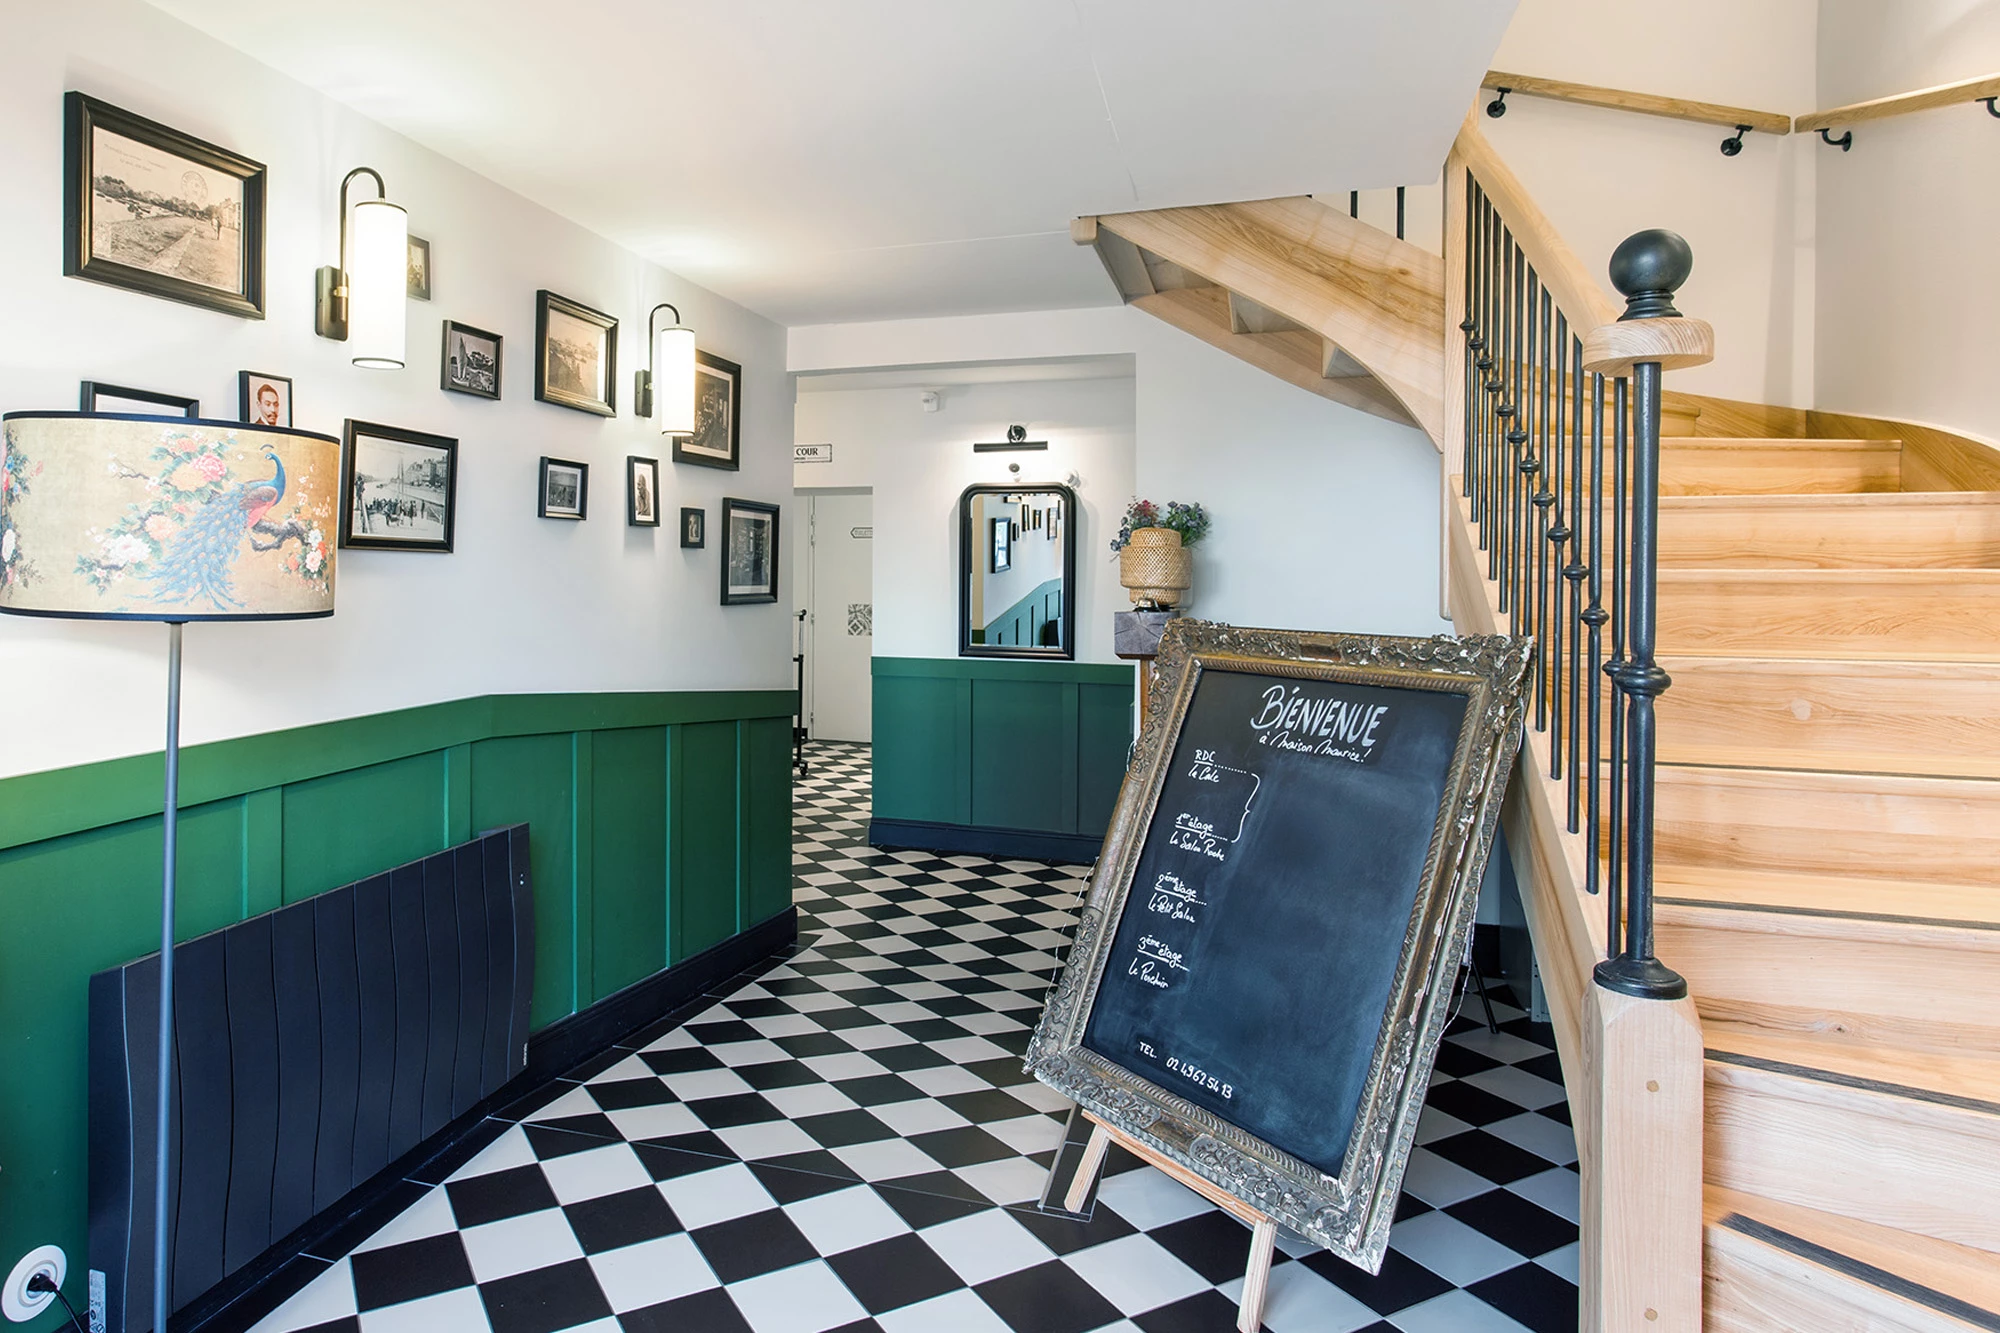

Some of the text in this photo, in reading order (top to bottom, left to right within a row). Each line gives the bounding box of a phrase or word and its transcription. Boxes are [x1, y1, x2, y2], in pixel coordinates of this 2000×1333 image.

[796, 447, 818, 456] COUR
[1259, 731, 1270, 744] à
[1195, 749, 1216, 763] RDC
[1188, 817, 1214, 839] étage
[1180, 833, 1201, 852] Salon
[1171, 902, 1195, 923] Salon
[1158, 944, 1182, 968] étage
[1140, 1041, 1158, 1059] TEL.
[1166, 1057, 1178, 1071] 02
